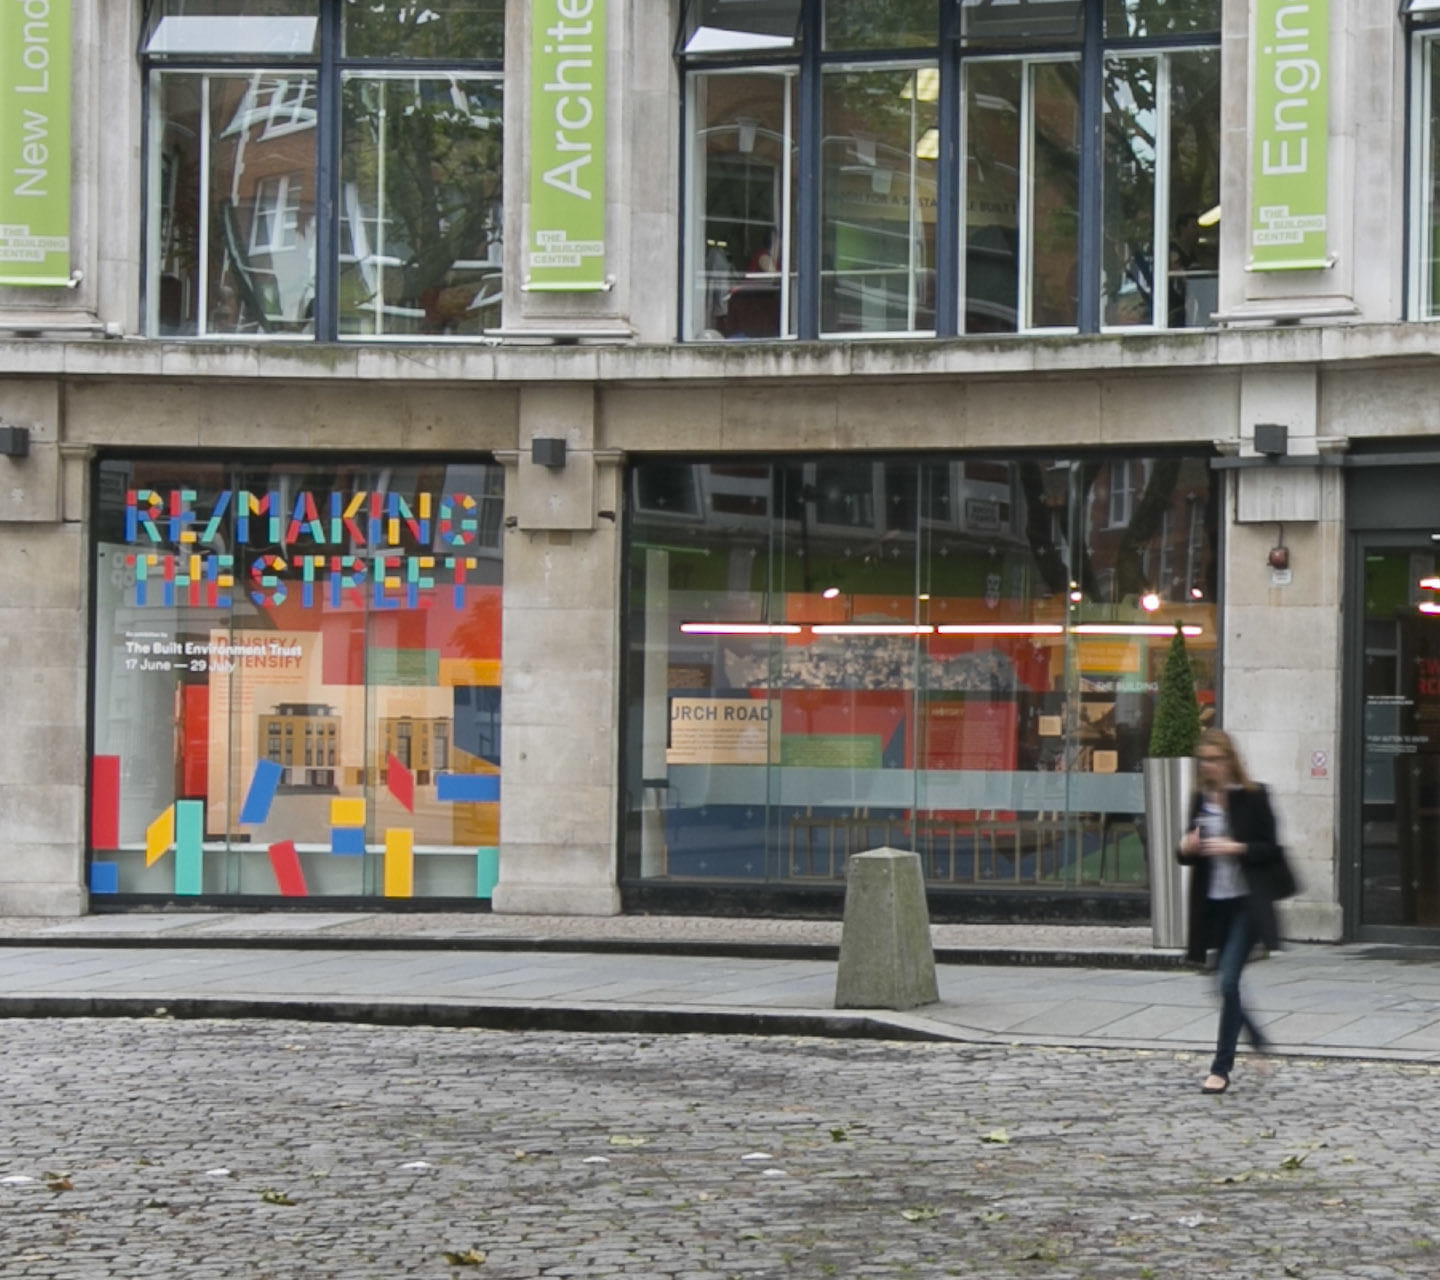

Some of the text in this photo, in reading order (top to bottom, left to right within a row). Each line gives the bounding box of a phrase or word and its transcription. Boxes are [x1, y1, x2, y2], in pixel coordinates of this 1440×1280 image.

[13, 109, 49, 197] New
[125, 554, 234, 607] THE
[251, 555, 477, 611] STREET
[125, 641, 302, 656] The Built Environment Trust
[126, 658, 138, 670] 17
[140, 659, 171, 671] June
[190, 659, 207, 672] 29
[208, 660, 236, 674] July
[724, 705, 773, 721] ROAD
